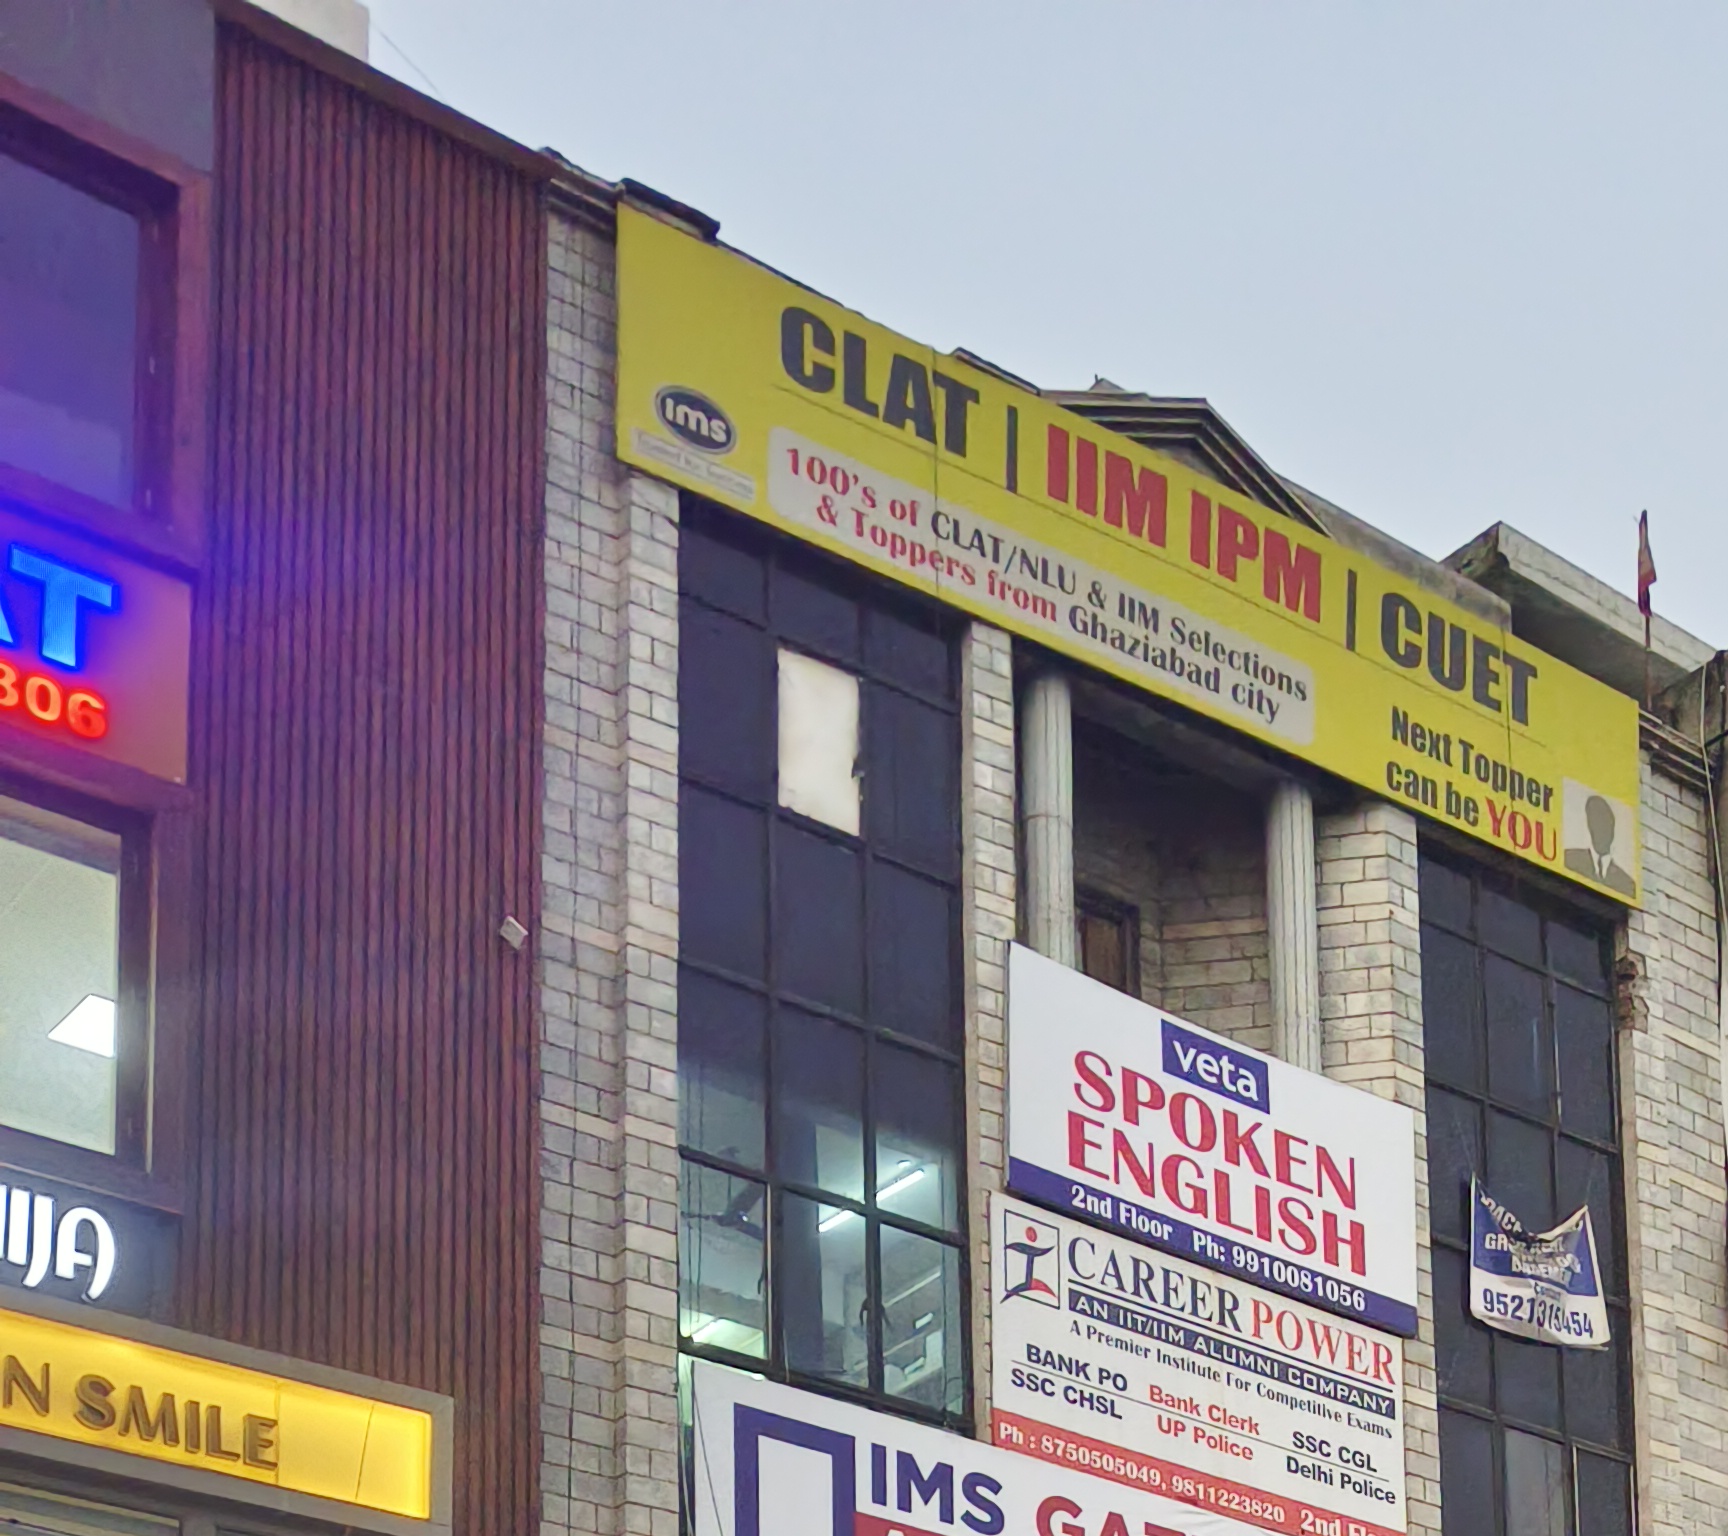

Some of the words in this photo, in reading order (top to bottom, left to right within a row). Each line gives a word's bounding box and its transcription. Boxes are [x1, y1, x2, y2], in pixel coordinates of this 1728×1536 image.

[780, 306, 980, 458] CLAT
[1047, 423, 1168, 549] IIM
[1190, 489, 1322, 623] IPM
[1380, 591, 1538, 726] CUET
[786, 447, 877, 508] 100's
[930, 510, 1077, 597] CLAT/NLU
[1118, 591, 1160, 634] IIM
[1170, 615, 1308, 702] Selections
[850, 506, 977, 587] Toppers
[987, 565, 1058, 622] from
[1069, 604, 1221, 695] Ghaziabad
[1230, 679, 1281, 726] city
[1390, 705, 1453, 768] Next
[1458, 742, 1554, 809] Topper
[1385, 760, 1439, 810] can
[1444, 782, 1480, 829] be
[1484, 797, 1558, 862] YOU
[1172, 1038, 1261, 1102] veta
[1073, 1049, 1357, 1210] SPOKEN
[1067, 1110, 1367, 1278] ENGLISH
[1070, 1185, 1113, 1221] 2nd
[1118, 1203, 1174, 1242] Floor
[1231, 1246, 1367, 1313] 9910081056
[1067, 1237, 1243, 1333] CAREER
[1250, 1299, 1397, 1386] POWER
[1074, 1293, 1109, 1320] AN
[1193, 1334, 1281, 1381] ALUMNI
[1286, 1368, 1392, 1413] COMPANY
[1010, 1369, 1057, 1399] SSC
[1062, 1383, 1123, 1420] CHSL
[1025, 1343, 1092, 1384] BANK
[1097, 1366, 1129, 1392] PO
[1087, 1325, 1153, 1360] Premier
[1156, 1345, 1222, 1384] Institute
[1256, 1379, 1342, 1429] Competitive
[1345, 1412, 1394, 1439] Exams
[1148, 1384, 1202, 1419] Bank
[1206, 1401, 1261, 1437] Clerk
[73, 1373, 279, 1470] SMILE
[1157, 1414, 1188, 1438] UP
[1193, 1424, 1255, 1462] Police
[1291, 1430, 1333, 1458] SSC
[1337, 1444, 1379, 1474] CGL
[870, 1441, 1006, 1536] IMS
[1286, 1456, 1335, 1488] Delhi
[1339, 1471, 1397, 1506] Police
